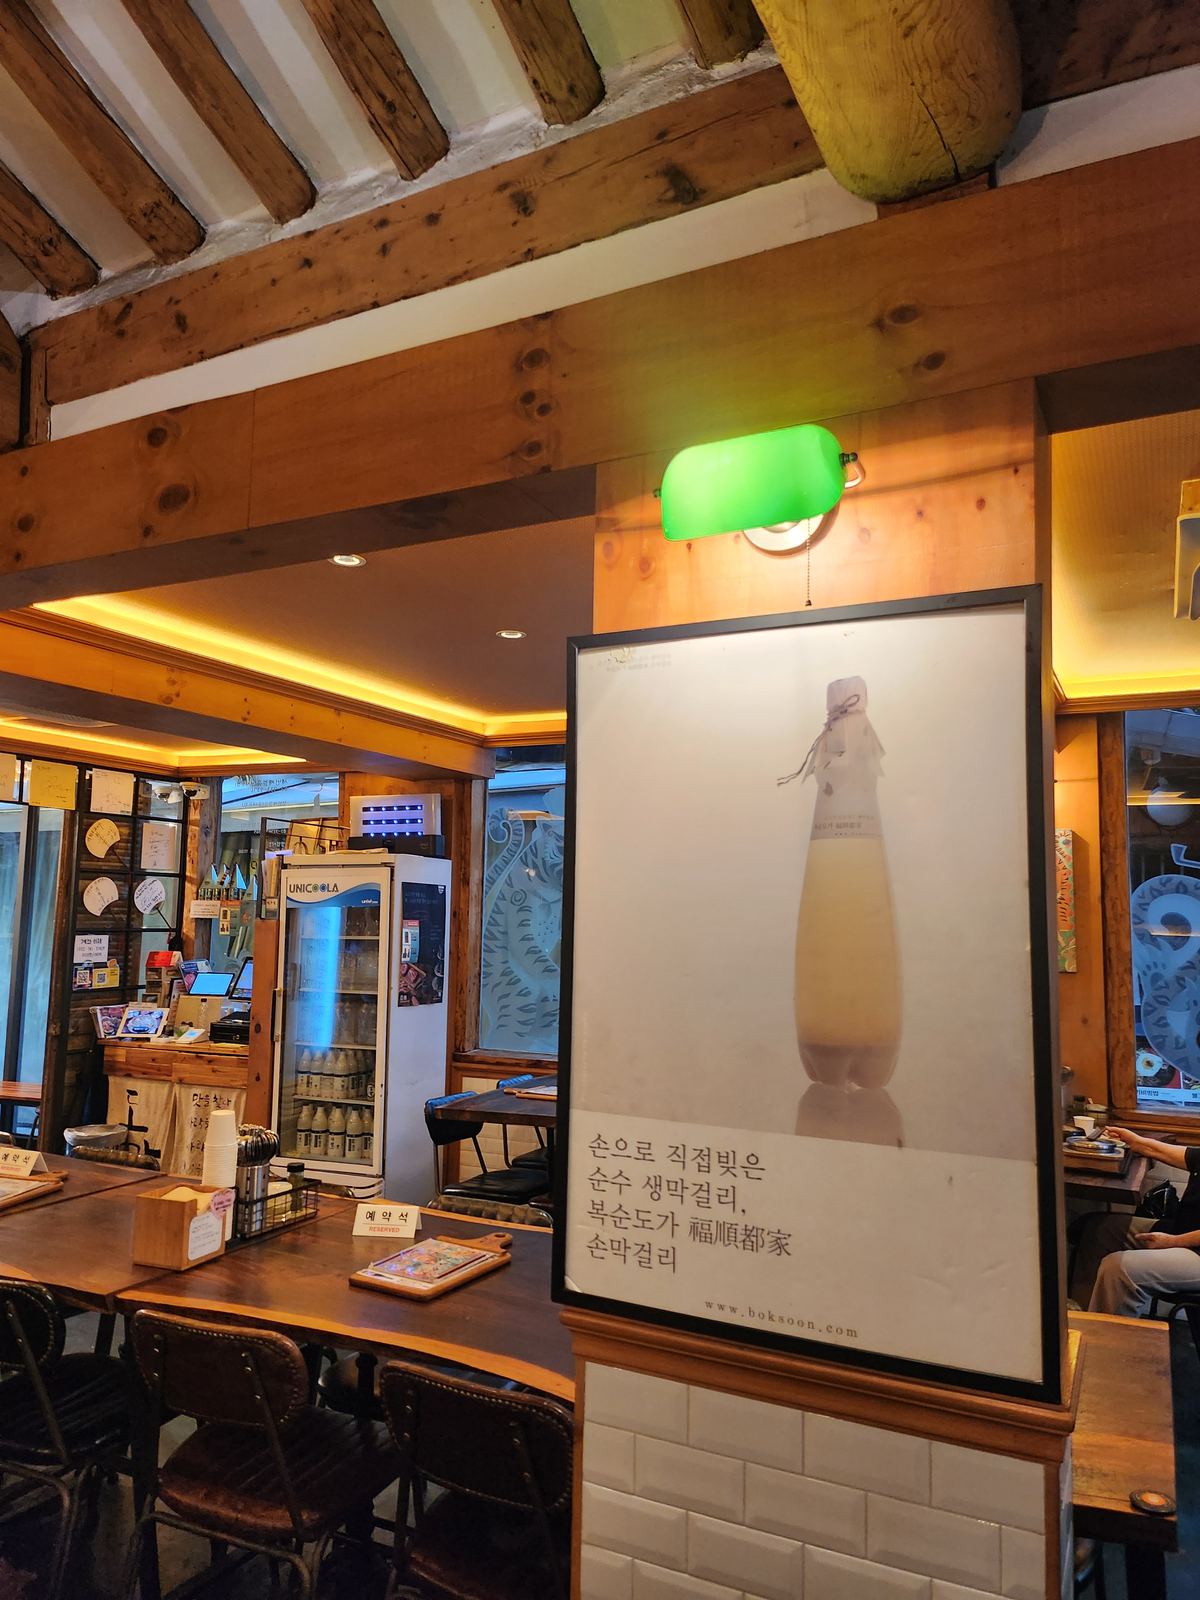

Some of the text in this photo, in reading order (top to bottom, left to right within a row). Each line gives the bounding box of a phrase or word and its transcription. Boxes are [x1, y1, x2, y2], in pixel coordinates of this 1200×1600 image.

[289, 883, 339, 893] UNICOOLA
[587, 1133, 656, 1163] 손으로
[587, 1166, 747, 1215] 순수 생막걸리,
[587, 1199, 792, 1257] 복순도가 福順都家
[586, 1233, 677, 1274] 손막걸리
[704, 1300, 858, 1338] www.boksoon.com
